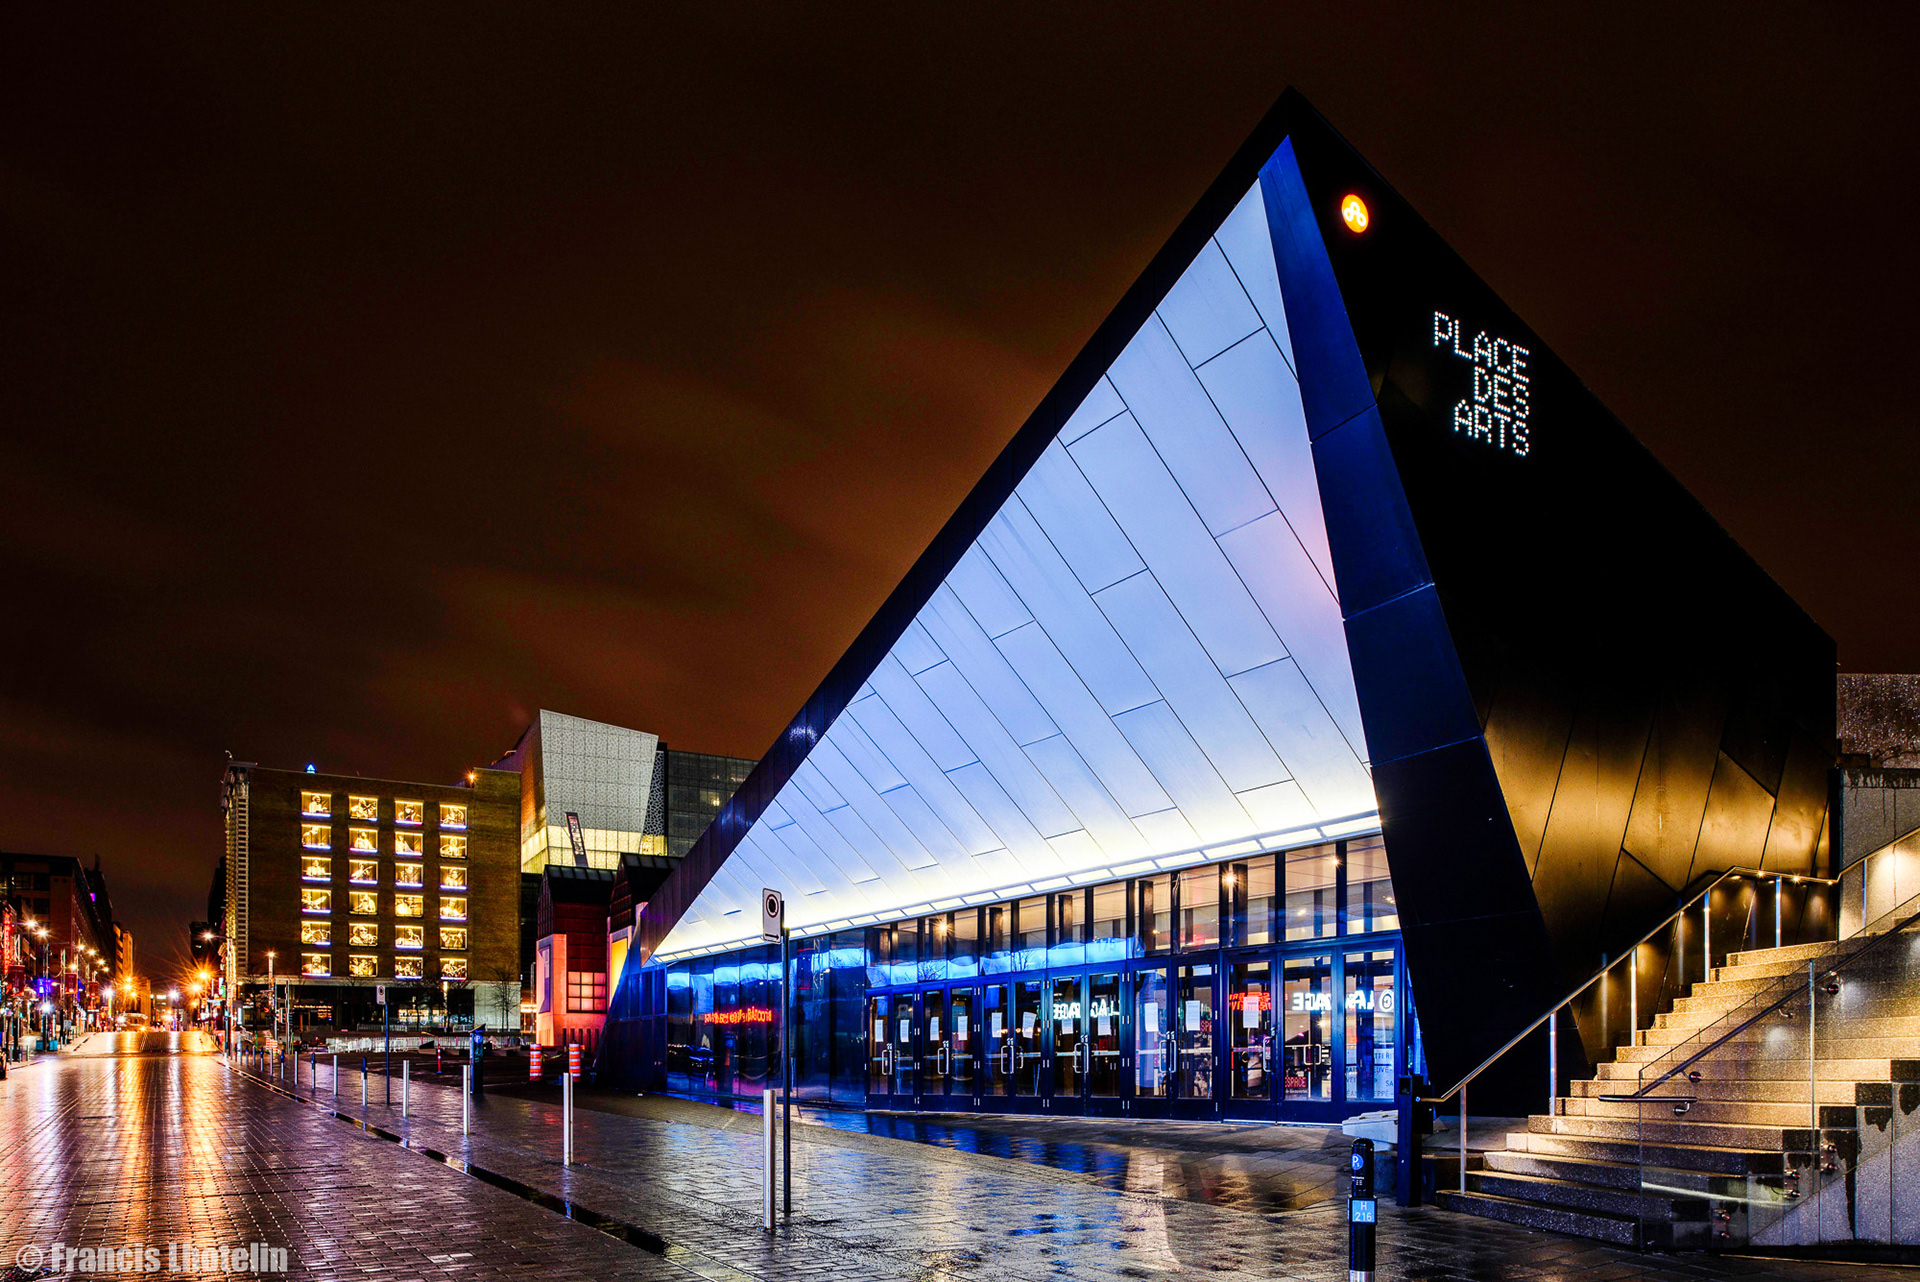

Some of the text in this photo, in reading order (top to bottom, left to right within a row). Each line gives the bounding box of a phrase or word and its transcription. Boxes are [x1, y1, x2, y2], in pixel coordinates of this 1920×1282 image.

[1434, 310, 1529, 383] PLACE
[1474, 365, 1529, 419] DES
[1454, 398, 1529, 456] ARTS
[1355, 1212, 1372, 1222] 216
[1361, 1201, 1367, 1211] H
